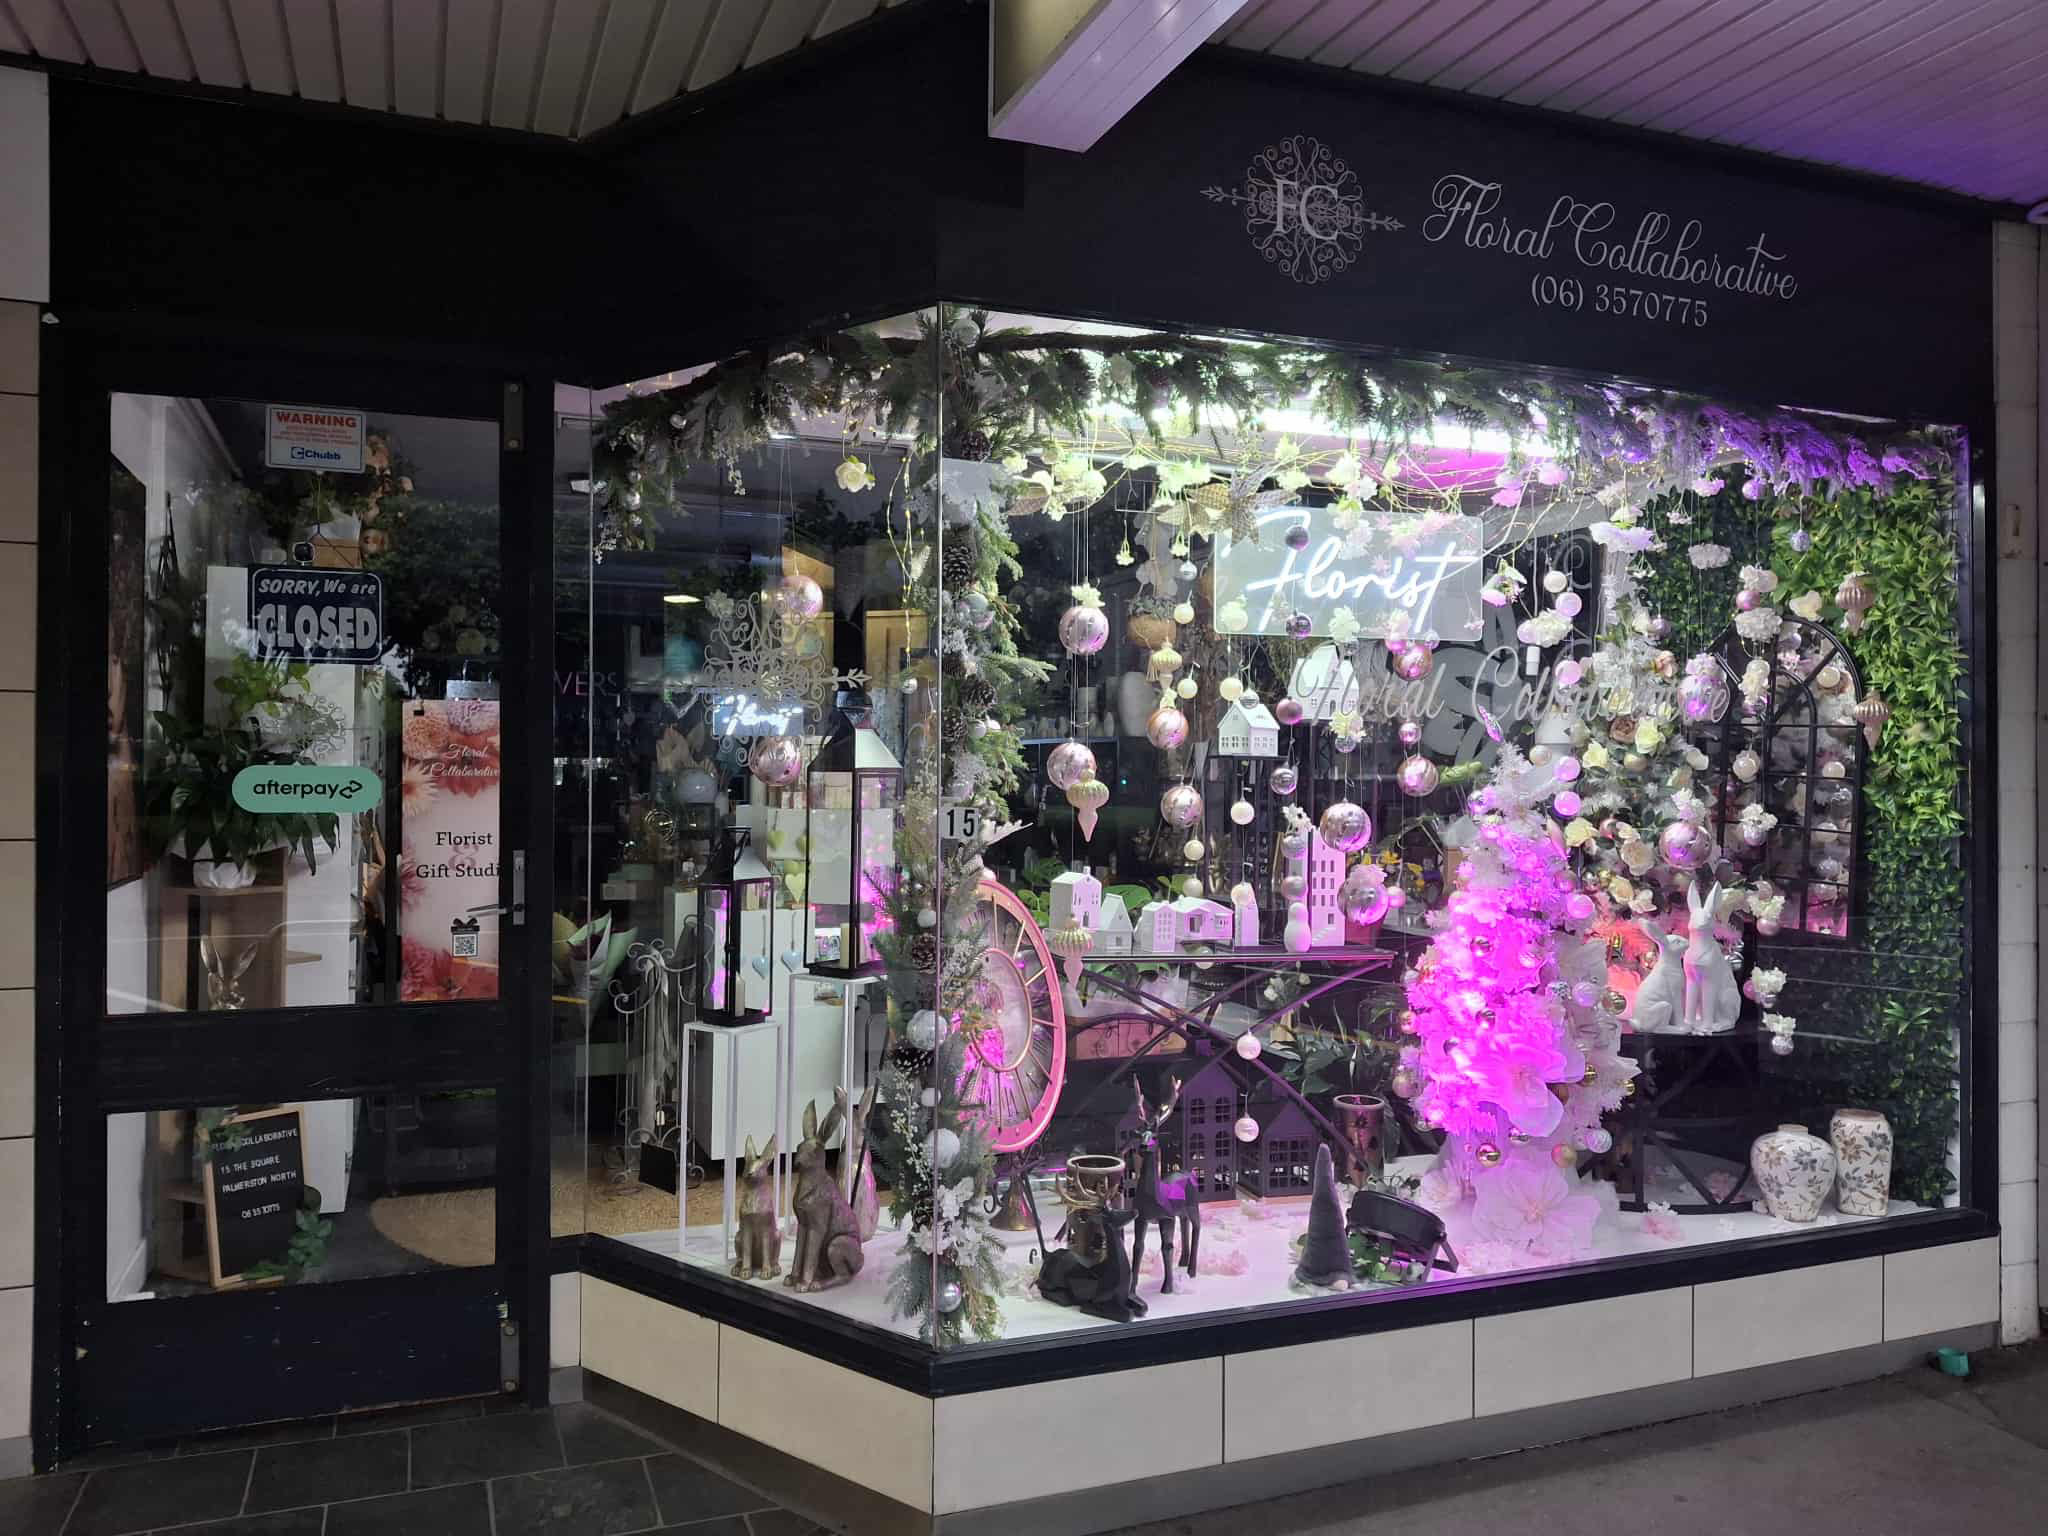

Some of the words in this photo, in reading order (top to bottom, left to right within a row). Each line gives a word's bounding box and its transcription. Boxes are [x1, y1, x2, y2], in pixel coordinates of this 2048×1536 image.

[1422, 173, 1574, 260] Floral
[1569, 200, 1799, 300] Collaborative
[1531, 275, 1584, 311] (06)
[1595, 284, 1709, 328] 3570775
[276, 410, 357, 429] WARNING
[304, 449, 341, 461] Chubb
[1221, 509, 1482, 632] Florist
[258, 579, 320, 597] SORRY,
[323, 579, 347, 594] We
[350, 584, 377, 595] are
[257, 603, 378, 650] CLOSED
[253, 780, 339, 799] afterpay
[946, 809, 975, 837] 15
[435, 831, 493, 846] Florist
[416, 864, 450, 878] Gift
[240, 1128, 297, 1146] COLLABORATIVE
[233, 1161, 248, 1173] THE
[250, 1155, 281, 1169] SQUARE
[222, 1176, 268, 1194] PALMERSTON
[270, 1170, 297, 1184] NORTH
